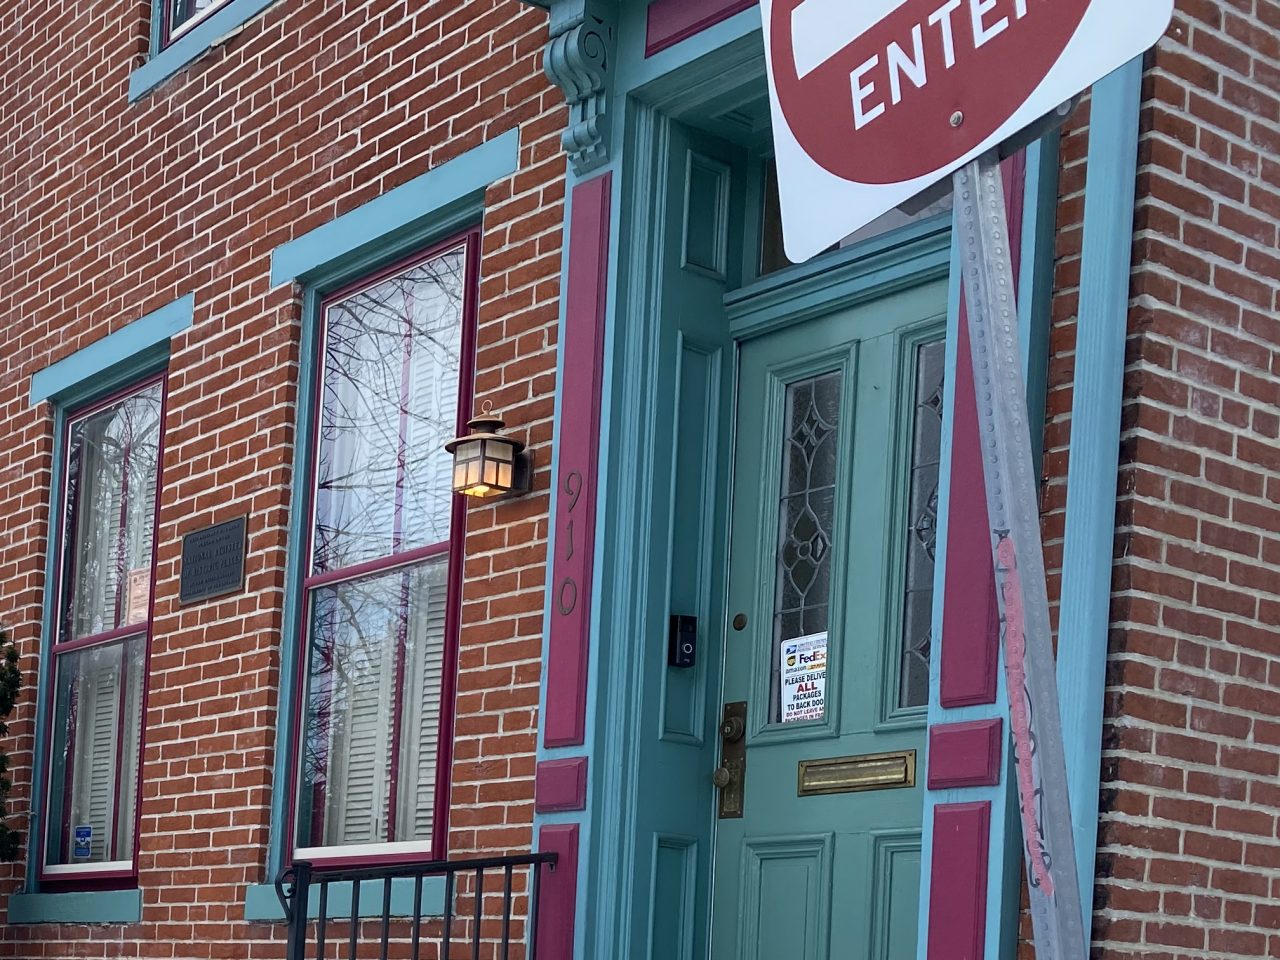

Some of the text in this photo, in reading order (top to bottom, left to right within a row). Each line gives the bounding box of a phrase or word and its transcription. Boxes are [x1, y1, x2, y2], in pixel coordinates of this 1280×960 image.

[557, 468, 582, 616] 910
[799, 651, 826, 664] FedEx
[785, 665, 807, 674] amazon
[785, 671, 826, 686] PLEASE DELIVE
[796, 682, 818, 693] ALL
[792, 690, 822, 701] PACKAGES
[787, 698, 824, 711] TO BACK DOO
[804, 707, 818, 715] LEAVE
